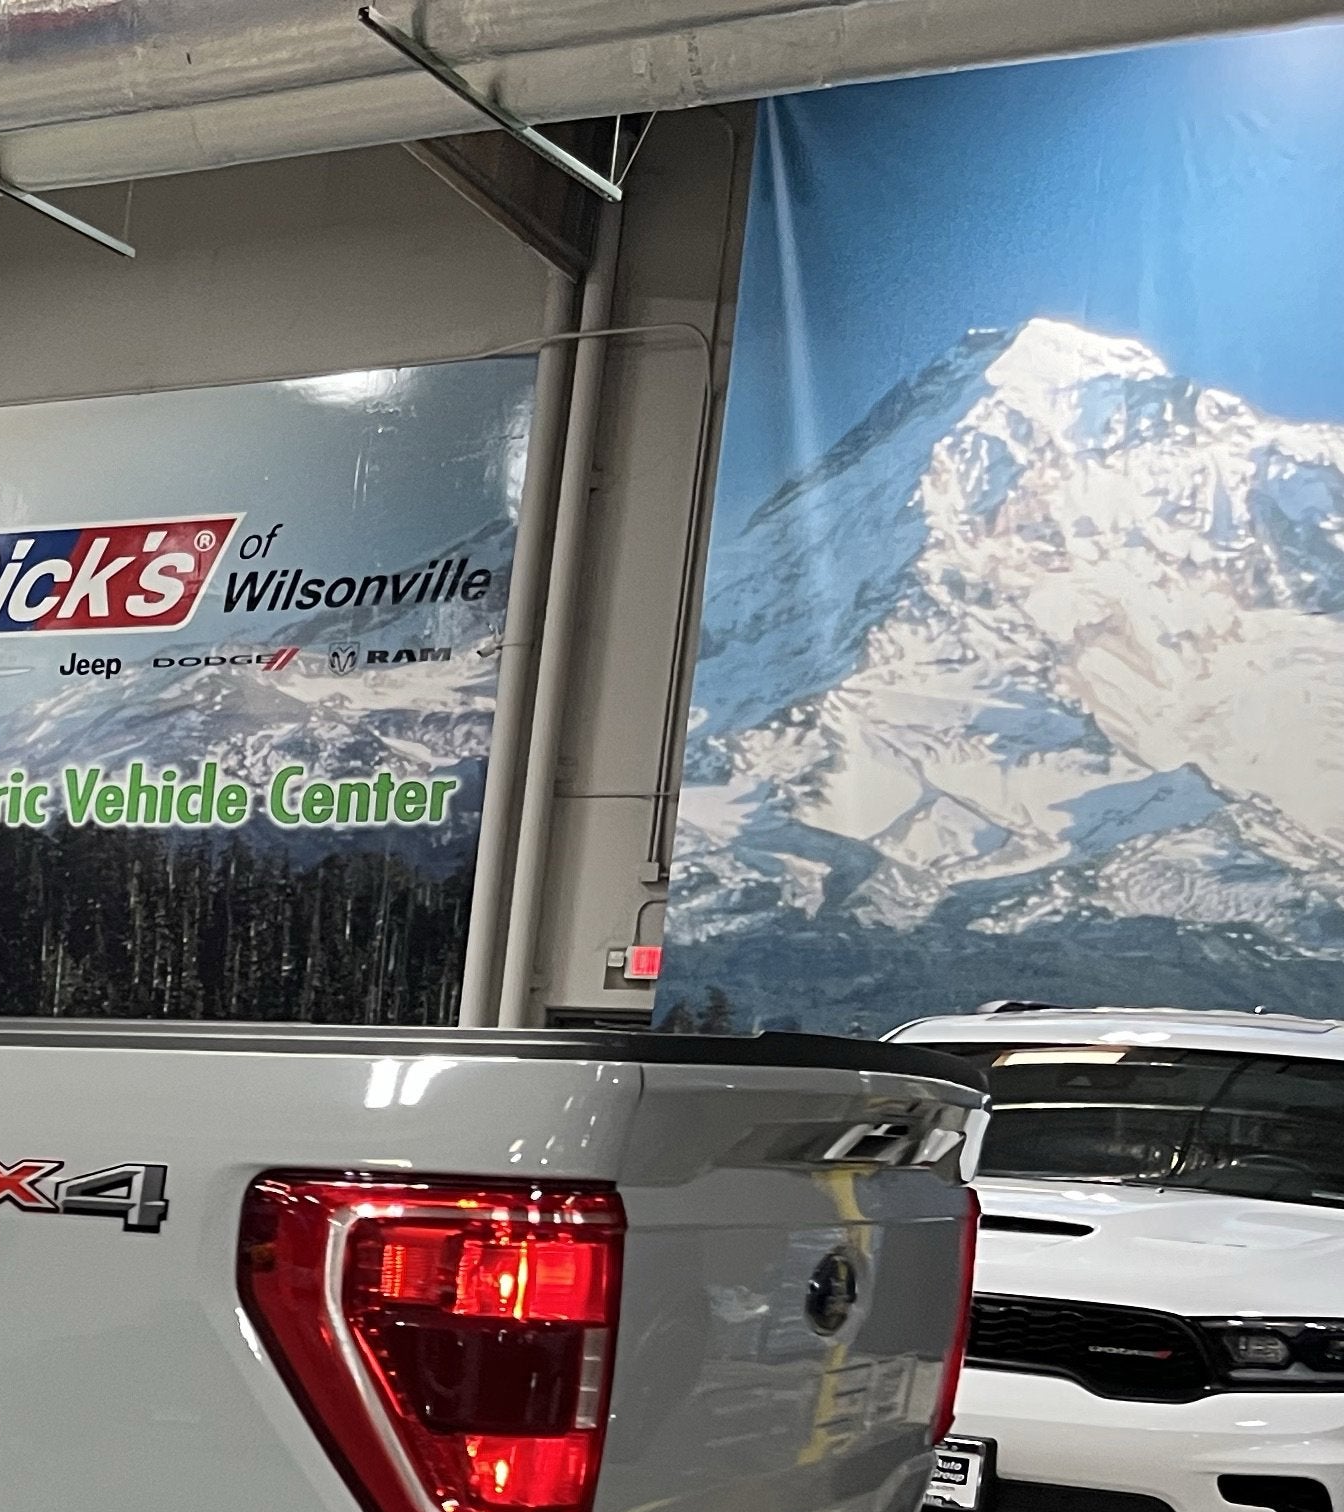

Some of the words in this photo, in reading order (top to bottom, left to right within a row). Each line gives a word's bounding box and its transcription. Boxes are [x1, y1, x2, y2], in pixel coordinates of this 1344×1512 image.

[239, 523, 283, 560] of
[223, 558, 492, 613] Wilsonville
[59, 652, 122, 679] Jeep
[152, 653, 280, 669] DODGE
[366, 647, 452, 664] RAM
[65, 762, 249, 824] Vehicle
[269, 765, 457, 824] Center
